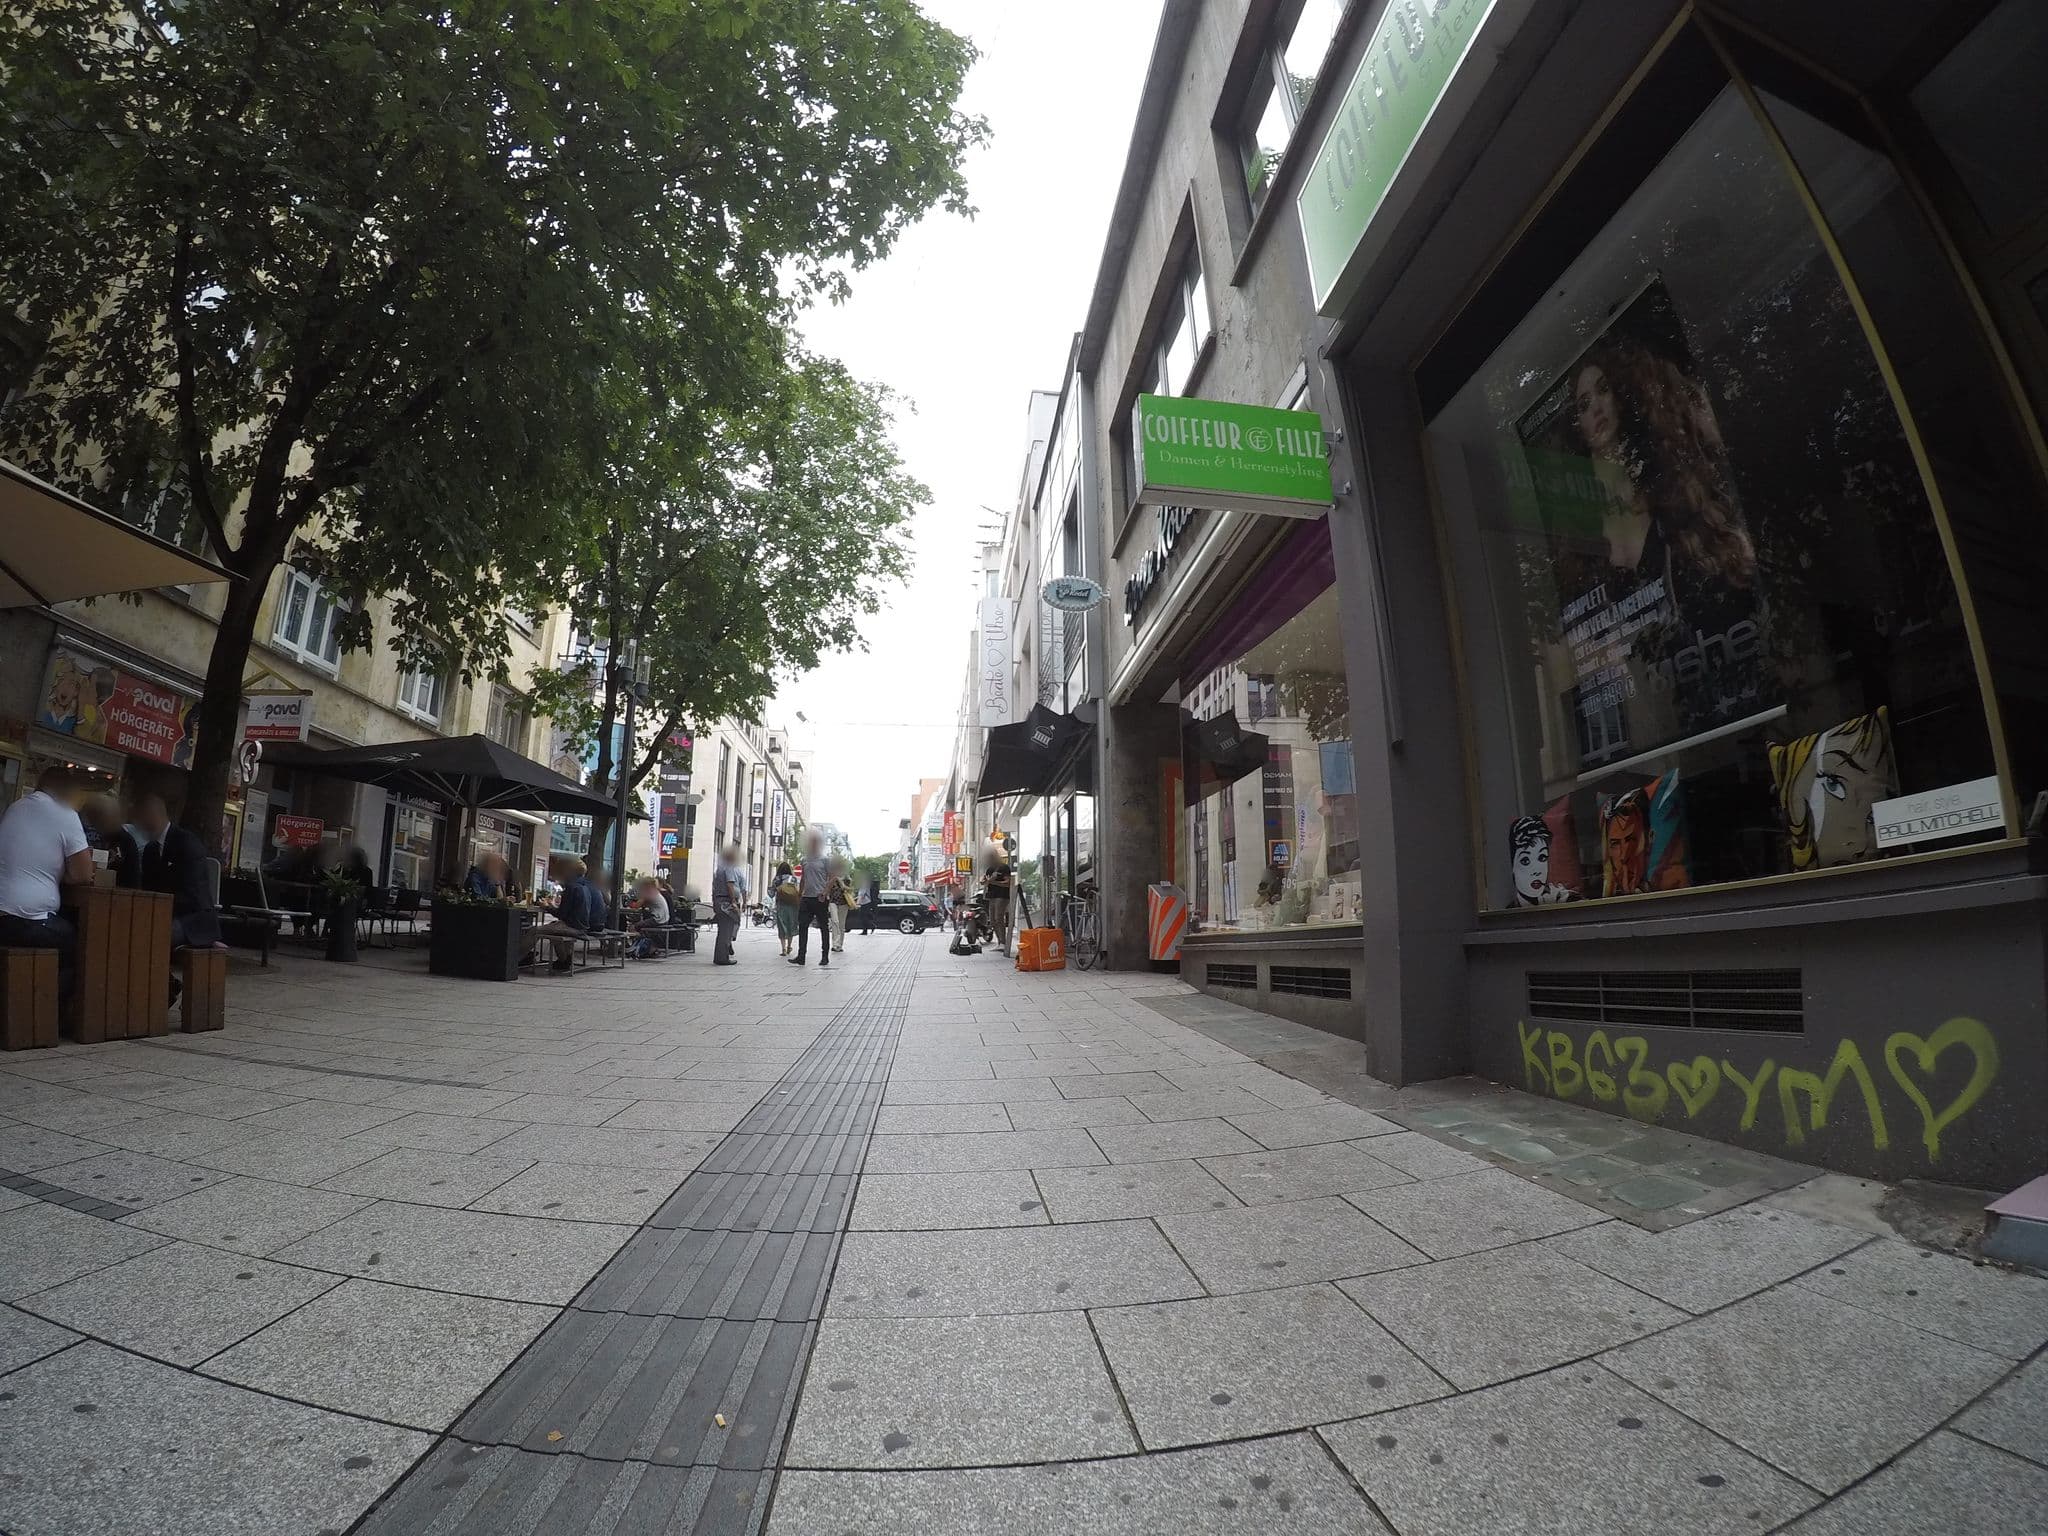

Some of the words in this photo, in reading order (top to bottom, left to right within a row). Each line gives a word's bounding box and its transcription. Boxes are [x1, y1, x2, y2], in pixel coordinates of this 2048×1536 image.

[1325, 0, 1448, 212] COIFFEU
[1145, 414, 1243, 451] COIFFEUR
[1275, 427, 1325, 459] FILIZ
[1159, 450, 1210, 467] Damen
[1214, 454, 1227, 467] &
[1230, 456, 1324, 479] Herrenstyling
[985, 605, 1008, 647] Uhse
[133, 687, 176, 714] paval
[265, 699, 301, 719] paval
[985, 669, 1008, 719] Beate
[110, 707, 175, 740] HÖRGERÄTE
[118, 732, 163, 757] BRILLEN
[1878, 822, 1919, 840] PAUL
[1920, 806, 2001, 832] MITCHELL
